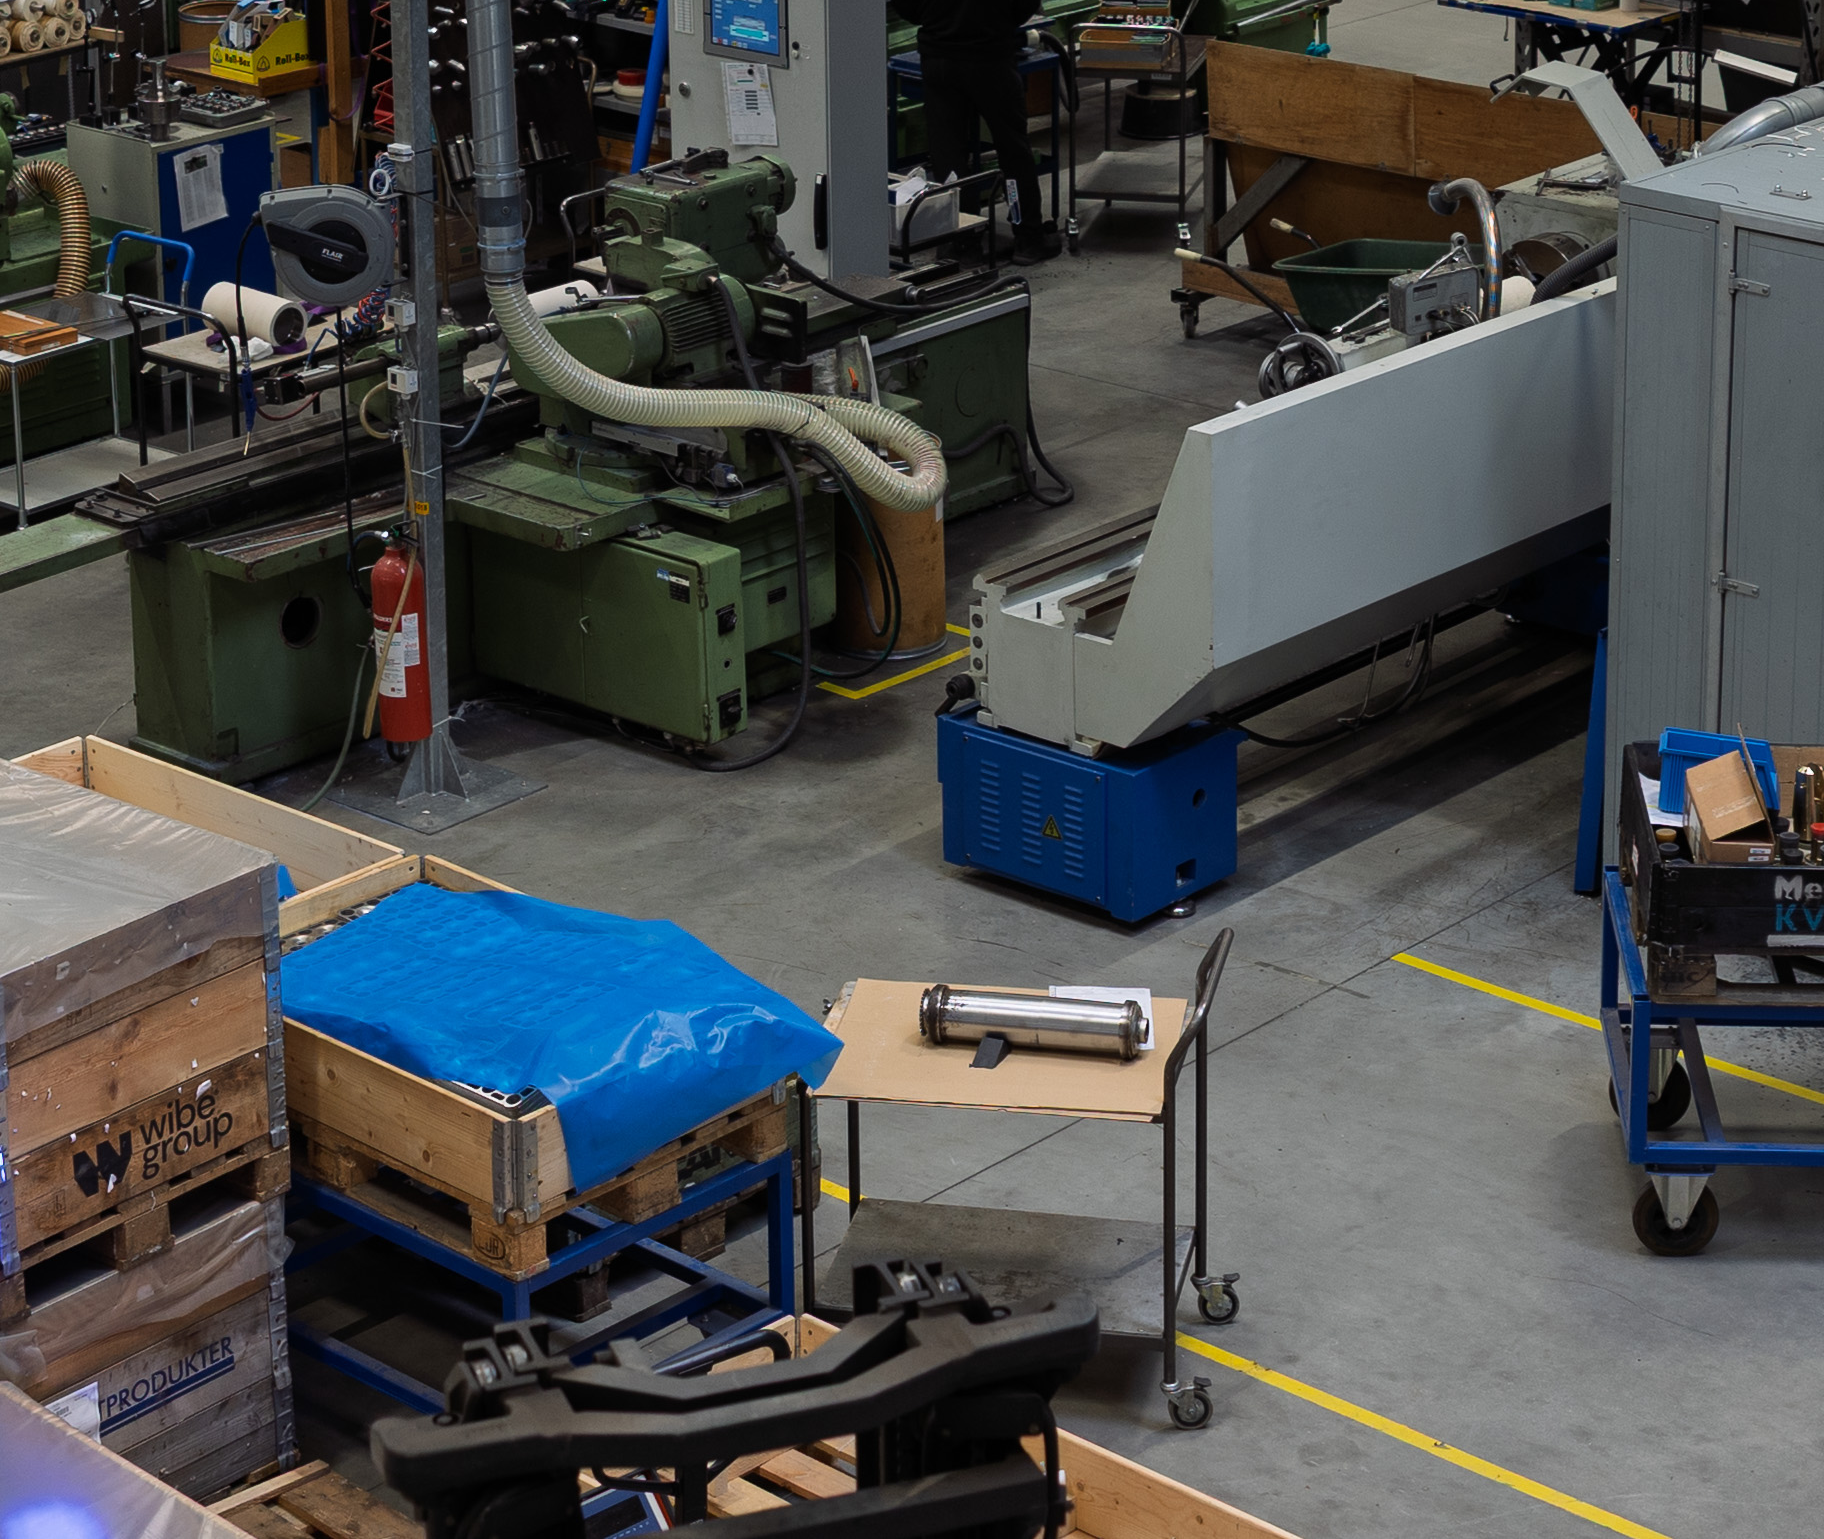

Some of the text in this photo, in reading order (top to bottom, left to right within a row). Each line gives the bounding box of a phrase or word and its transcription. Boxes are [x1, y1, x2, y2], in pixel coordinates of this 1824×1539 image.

[322, 247, 344, 260] FLAIR
[139, 1094, 216, 1145] wibe
[142, 1111, 233, 1181] group
